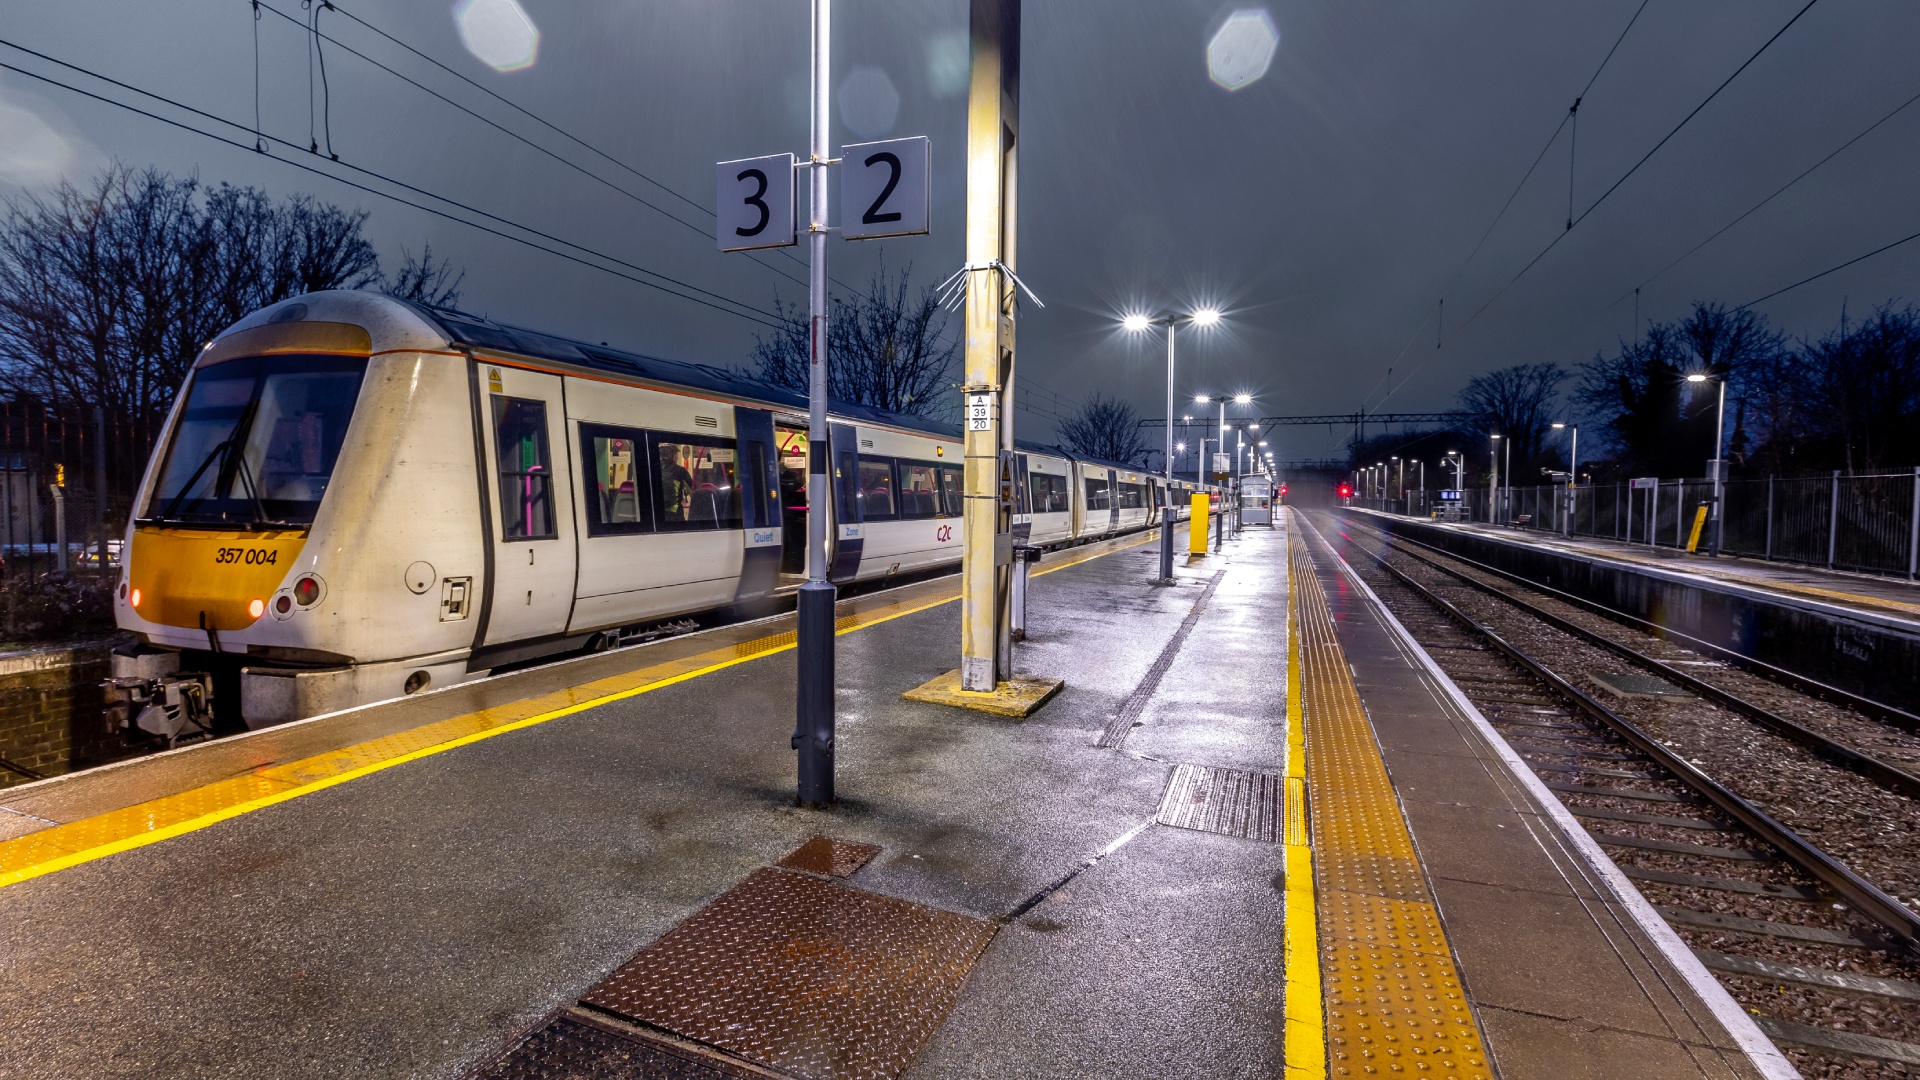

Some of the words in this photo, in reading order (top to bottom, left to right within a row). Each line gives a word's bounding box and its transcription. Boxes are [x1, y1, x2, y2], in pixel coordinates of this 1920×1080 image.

[861, 151, 902, 225] 2
[735, 168, 770, 237] 3
[977, 396, 983, 404] A
[974, 408, 986, 417] 39
[974, 421, 986, 429] 20
[846, 528, 858, 536] Zone
[937, 525, 951, 542] c2c
[754, 533, 773, 543] Quiet
[216, 548, 244, 563] 357
[245, 549, 277, 565] 004
